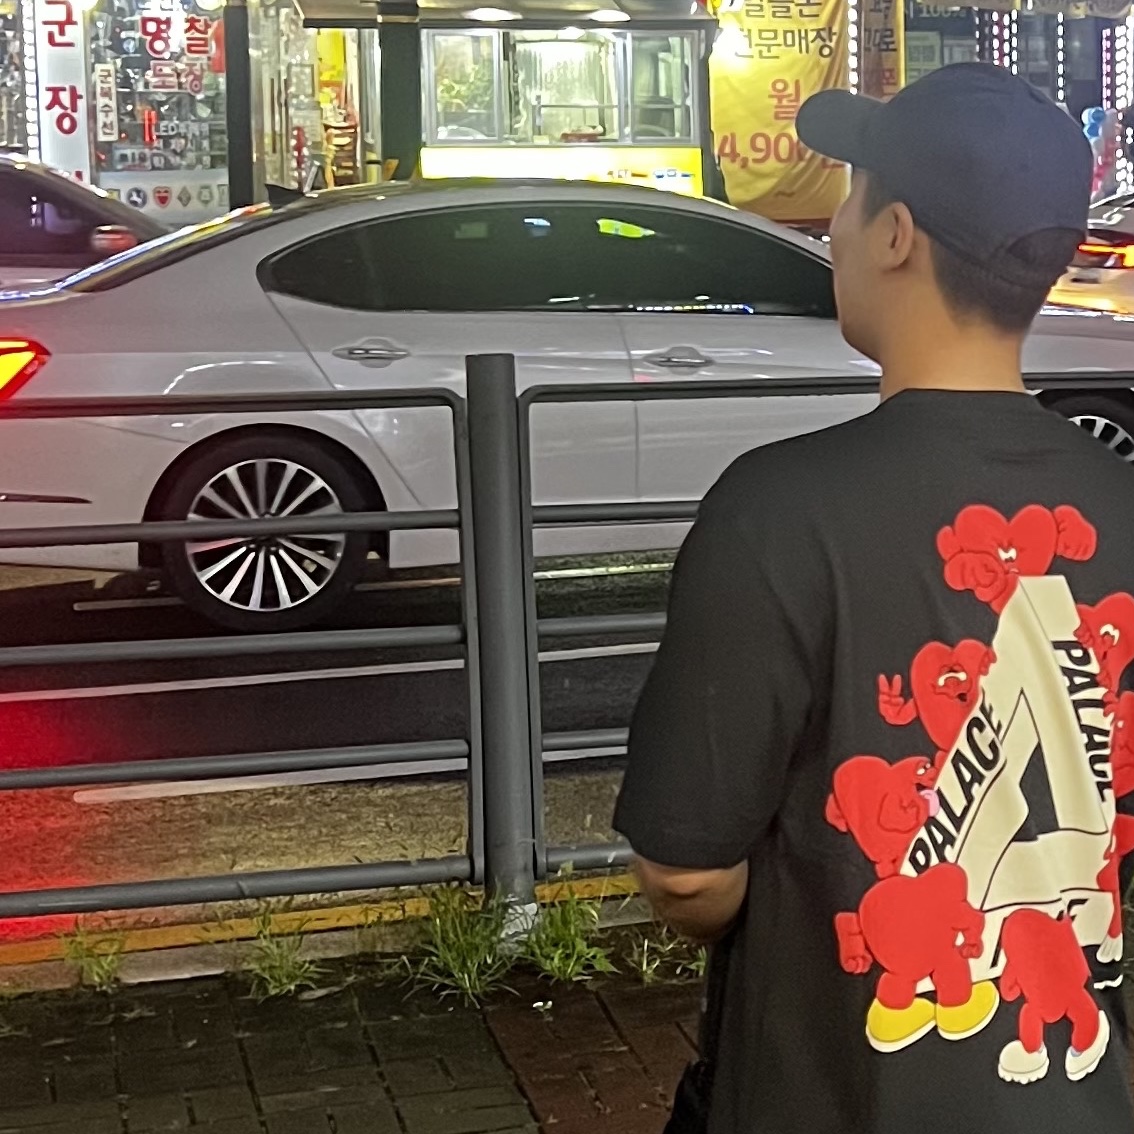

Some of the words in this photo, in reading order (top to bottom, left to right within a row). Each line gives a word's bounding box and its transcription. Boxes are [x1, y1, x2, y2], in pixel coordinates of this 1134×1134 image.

[140, 14, 211, 57] 명찰
[42, 0, 83, 182] 군장
[768, 79, 800, 120] 월
[718, 132, 847, 170] 4,90
